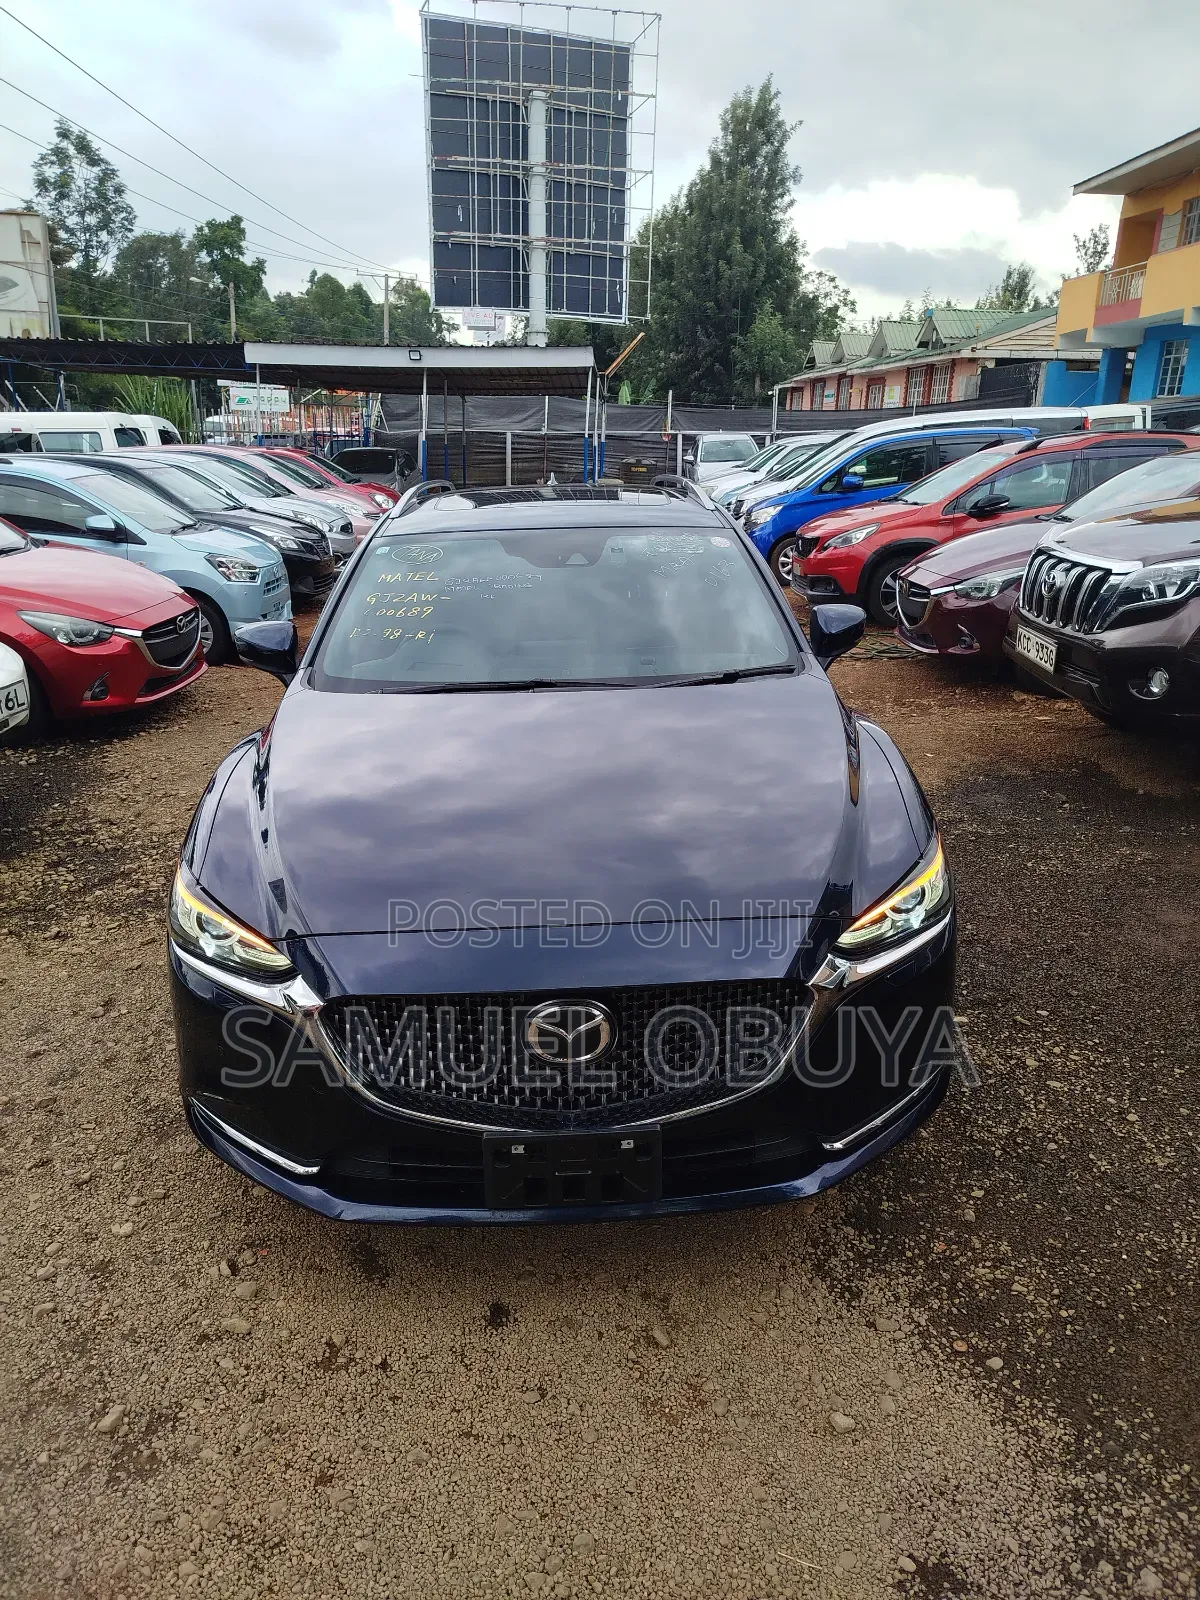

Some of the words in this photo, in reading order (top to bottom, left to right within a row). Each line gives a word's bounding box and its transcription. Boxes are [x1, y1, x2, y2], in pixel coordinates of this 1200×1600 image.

[377, 571, 440, 583] MATEL
[1018, 631, 1031, 653] KCC
[1036, 641, 1053, 667] 933G
